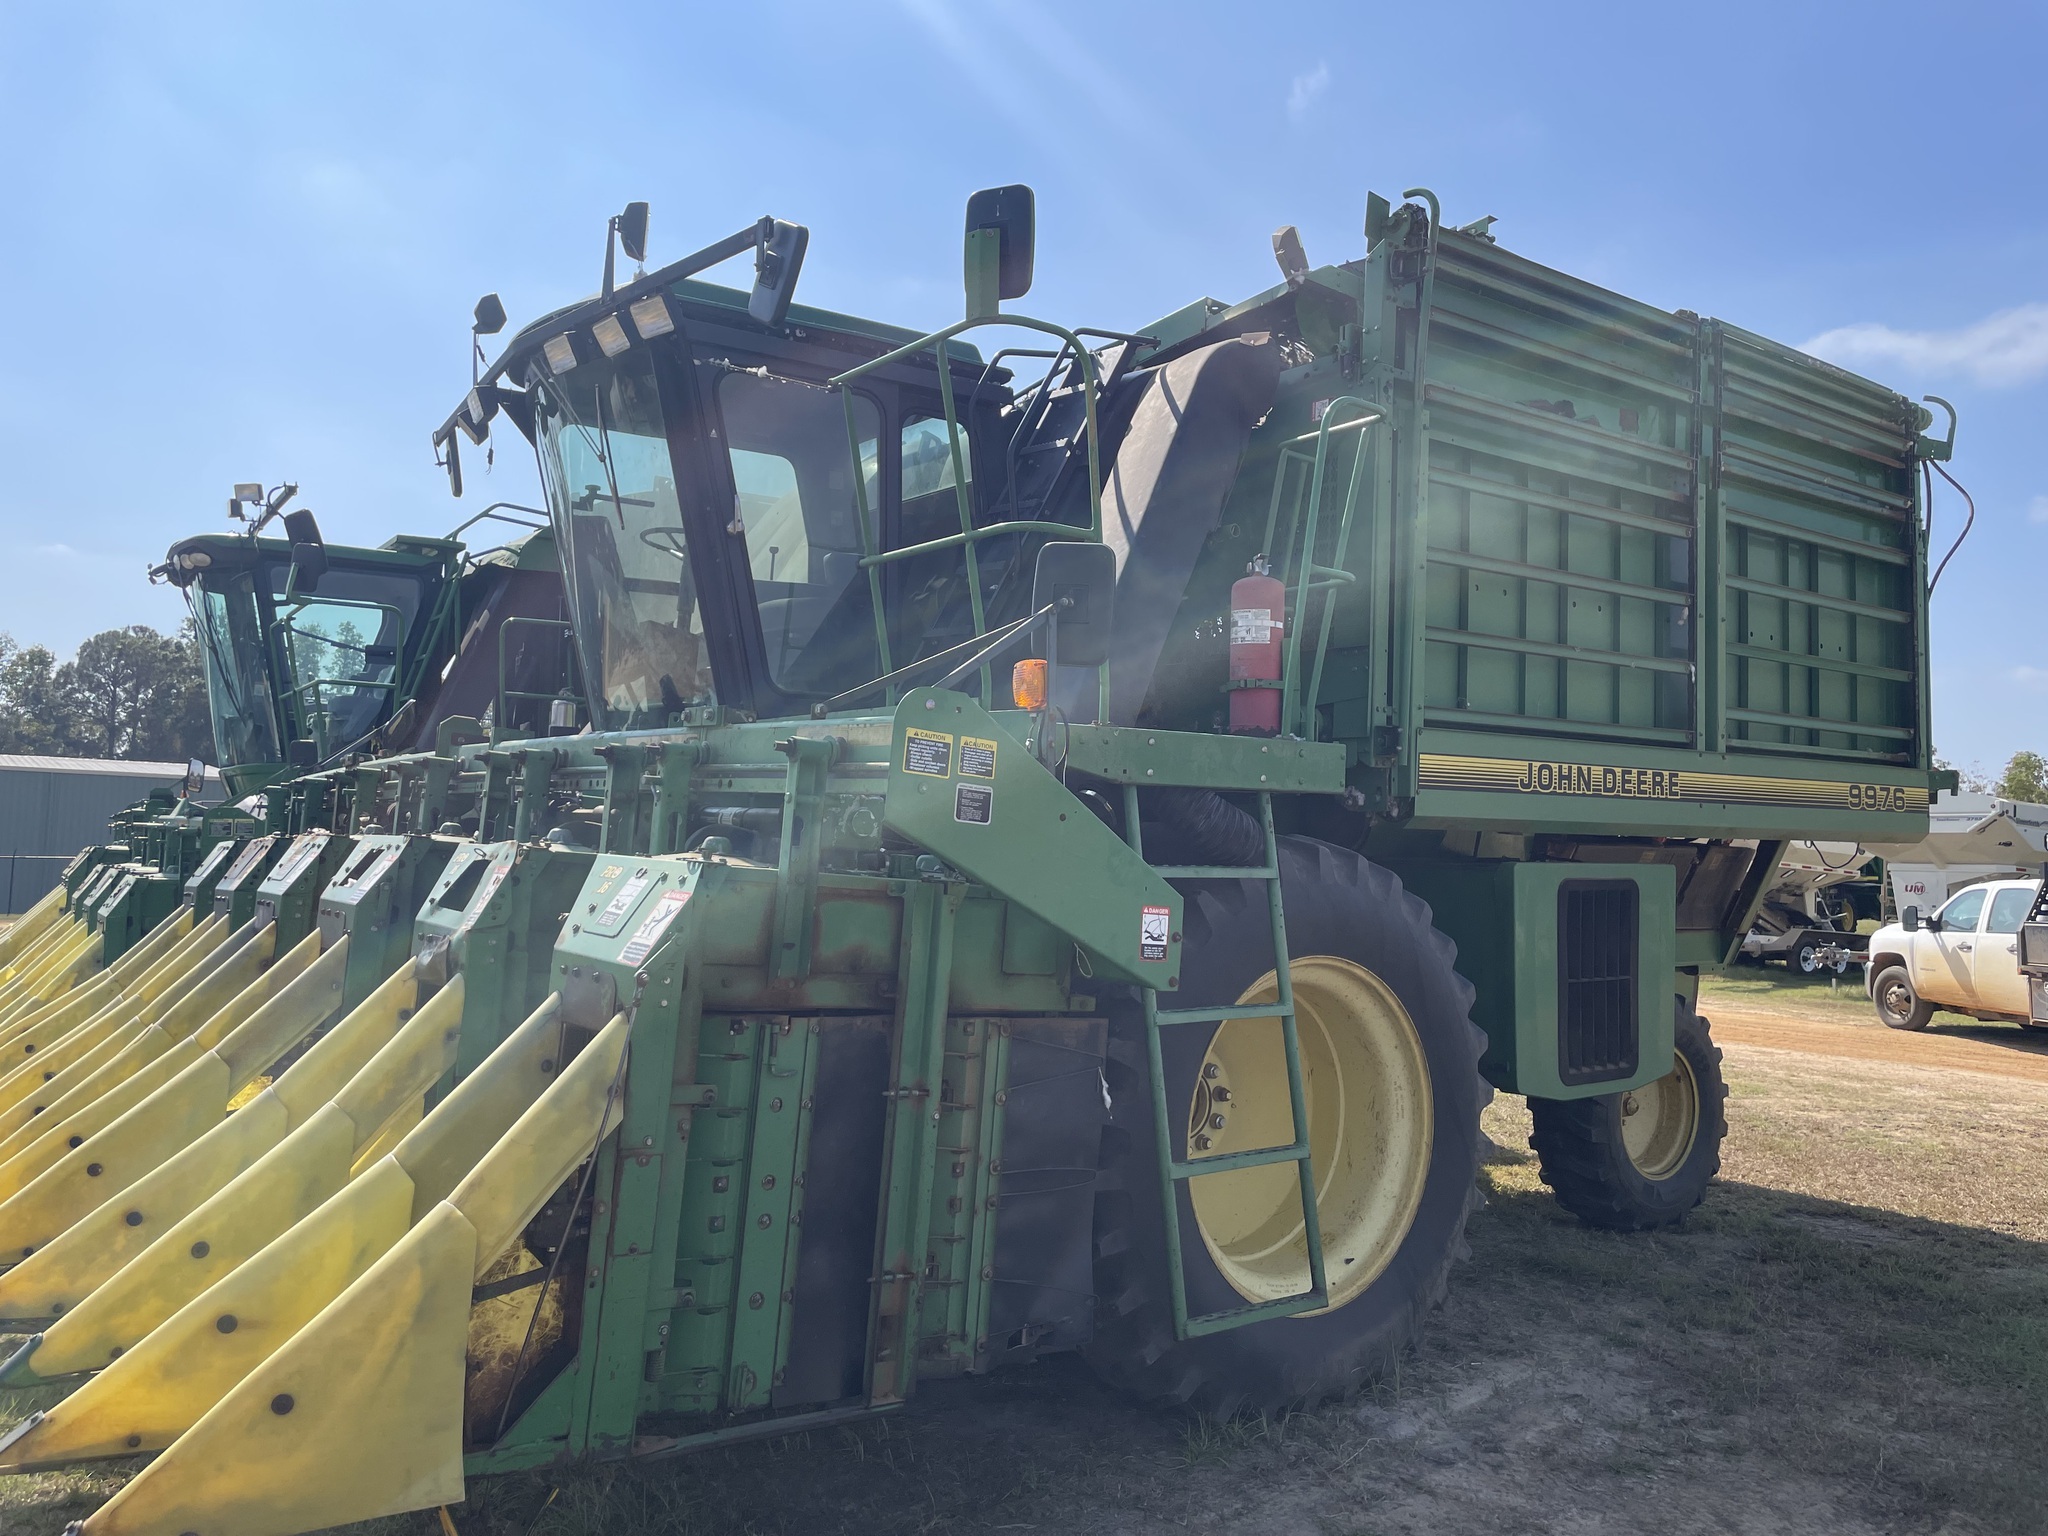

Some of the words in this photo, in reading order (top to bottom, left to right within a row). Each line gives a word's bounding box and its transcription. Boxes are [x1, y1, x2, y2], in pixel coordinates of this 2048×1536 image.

[920, 731, 946, 741] CAUTION
[969, 740, 993, 750] CAUTION
[1518, 762, 1593, 794] JOHN
[1602, 766, 1681, 799] DEERE
[1848, 784, 1906, 812] 9976
[599, 865, 624, 879] PRO
